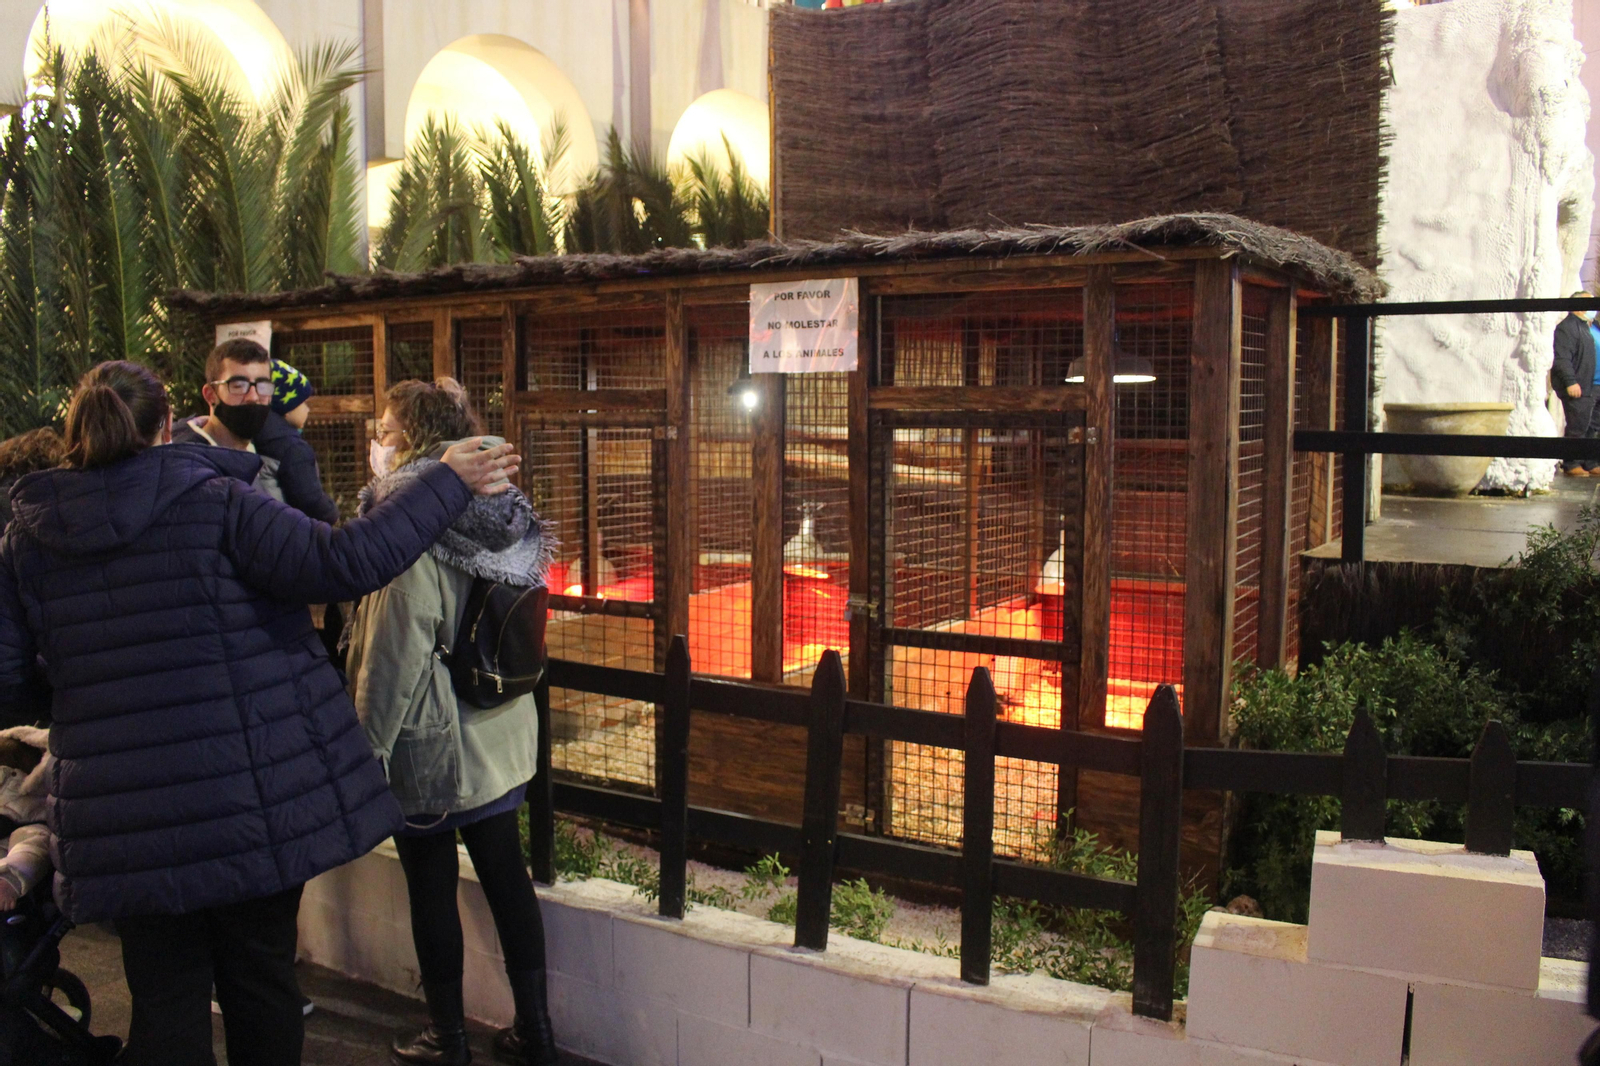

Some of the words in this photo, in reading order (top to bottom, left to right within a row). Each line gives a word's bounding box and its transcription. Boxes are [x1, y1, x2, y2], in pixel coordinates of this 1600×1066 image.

[774, 291, 794, 301] POR
[797, 290, 831, 300] FAVOR
[767, 321, 782, 330] NO
[785, 319, 838, 329] MOLESTAR
[763, 350, 770, 359] A
[772, 350, 793, 359] LOS
[795, 348, 844, 358] ANIMALES
